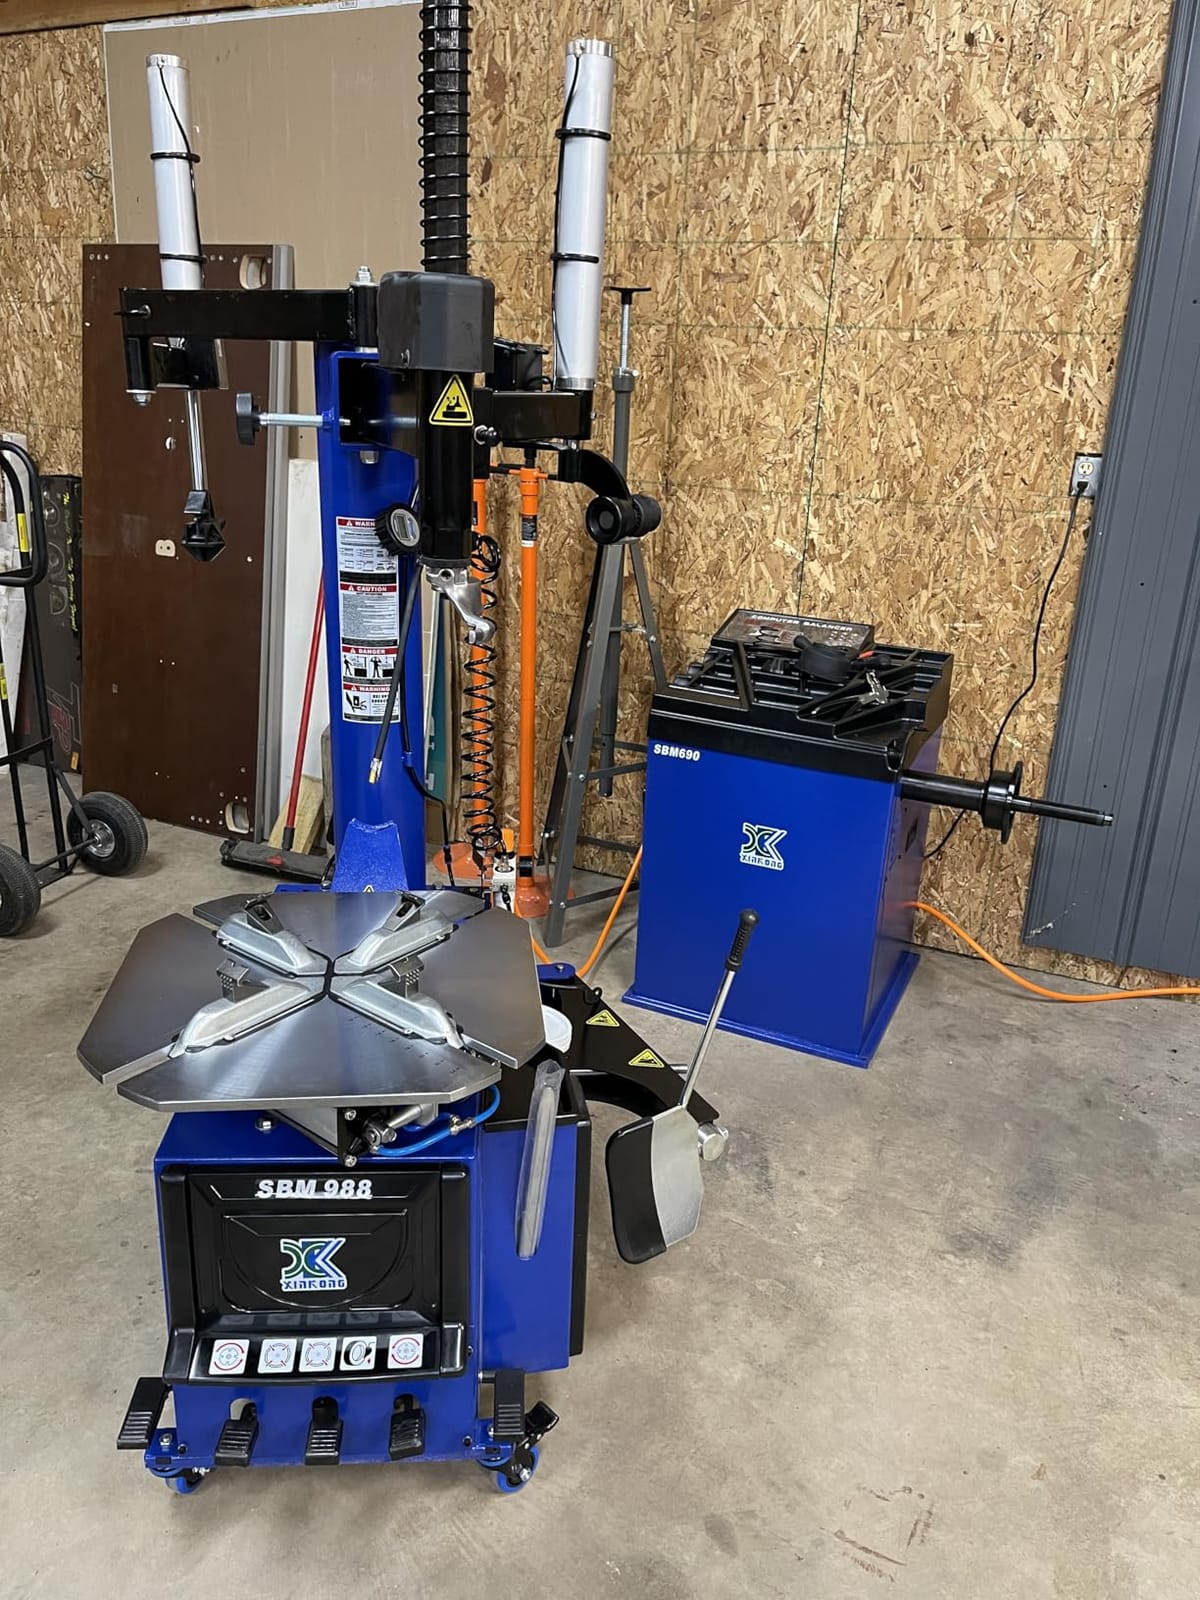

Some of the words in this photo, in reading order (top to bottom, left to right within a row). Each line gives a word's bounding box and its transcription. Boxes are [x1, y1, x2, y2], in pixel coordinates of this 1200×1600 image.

[751, 614, 800, 625] COMPUTER
[803, 621, 853, 631] BALANCER
[653, 743, 701, 761] SBM690
[258, 1179, 317, 1198] SBM
[323, 1179, 373, 1199] 988
